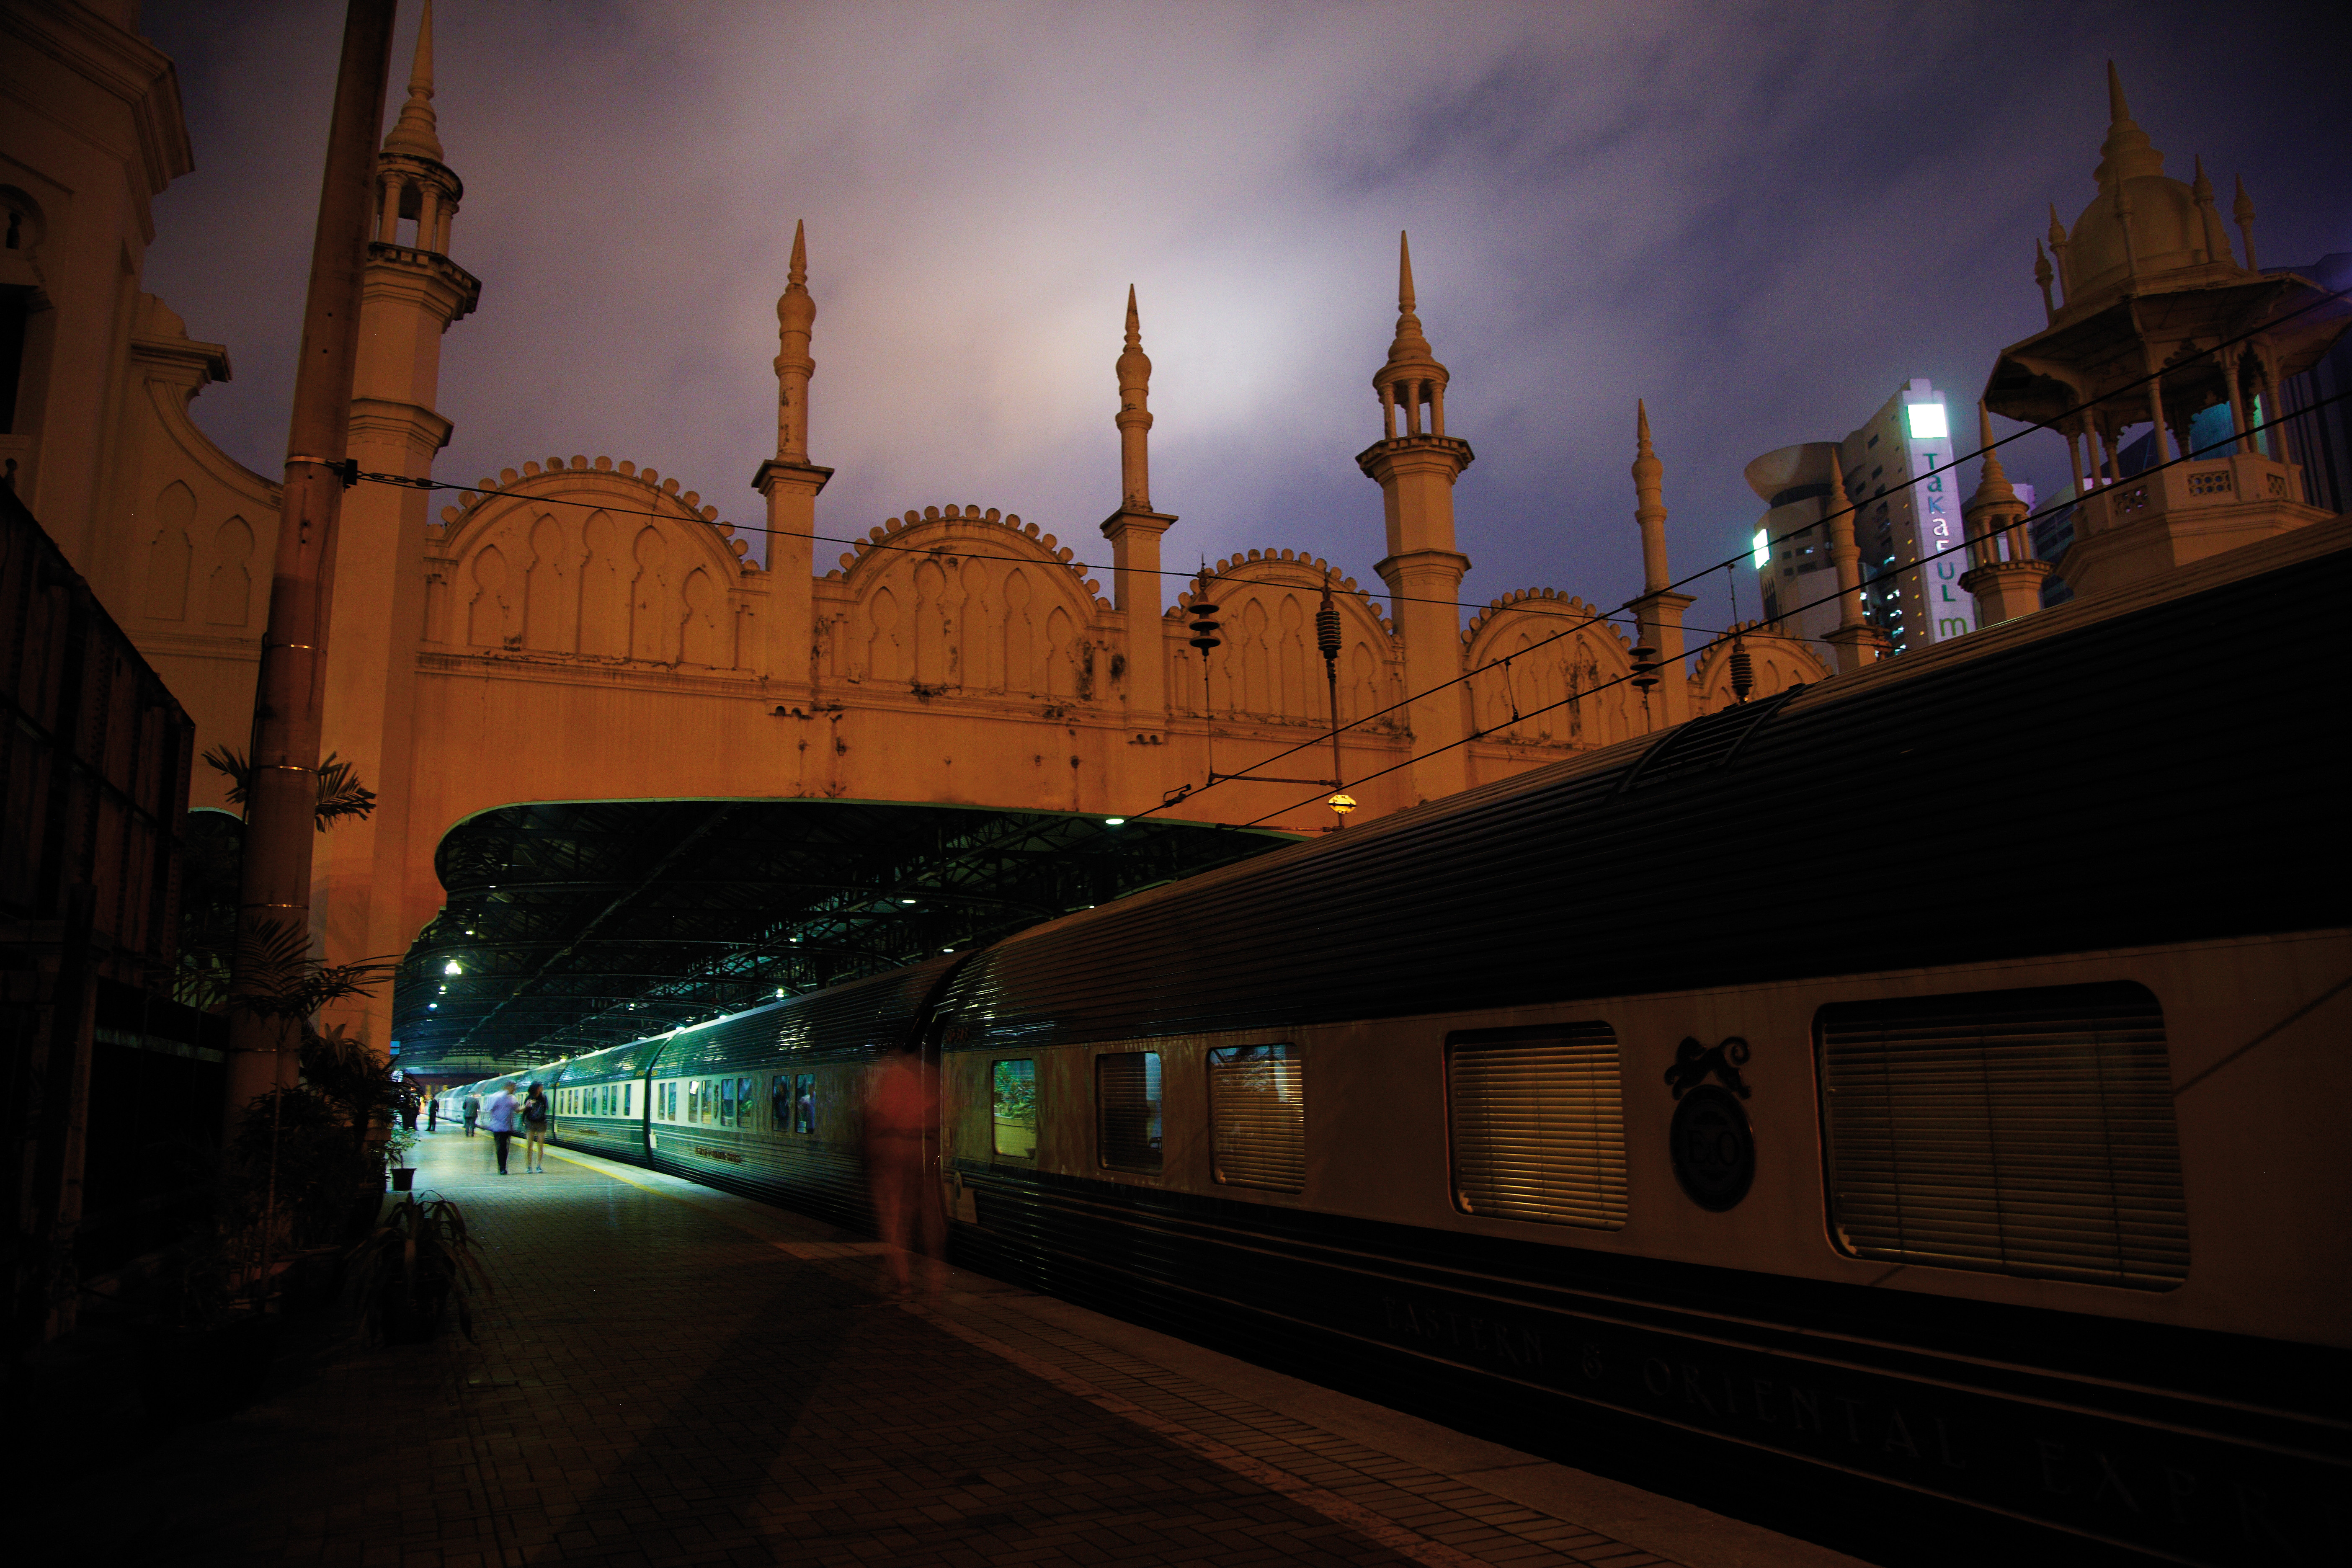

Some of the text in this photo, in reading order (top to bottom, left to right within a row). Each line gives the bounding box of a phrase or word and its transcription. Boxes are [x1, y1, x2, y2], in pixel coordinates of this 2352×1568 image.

[1382, 1295, 1544, 1367] EASTERN
[1581, 1342, 1604, 1380] &
[1643, 1356, 1967, 1470] ORIENTAL
